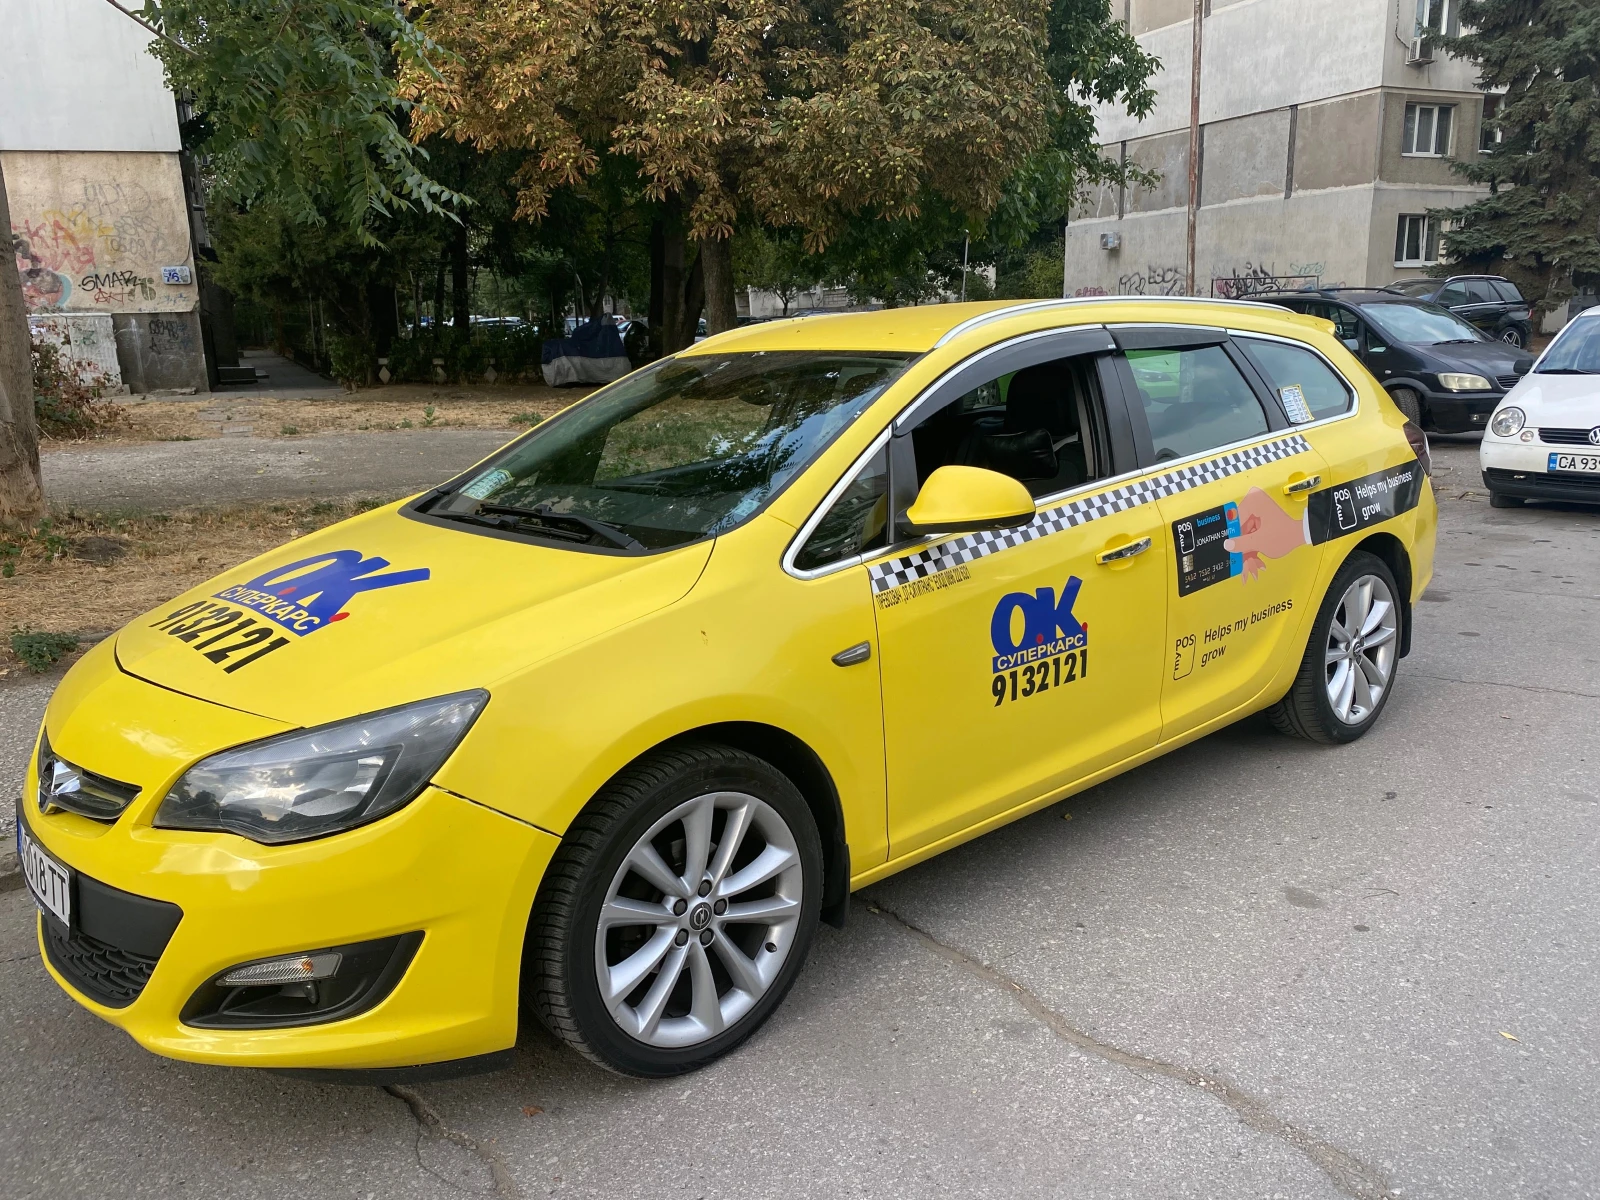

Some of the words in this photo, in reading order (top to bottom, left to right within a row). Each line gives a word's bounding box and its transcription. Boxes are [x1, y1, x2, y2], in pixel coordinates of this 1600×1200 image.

[1559, 456, 1577, 470] CA
[1581, 457, 1600, 471] 93
[1355, 484, 1377, 499] Helps
[1377, 480, 1388, 493] my
[1387, 471, 1413, 489] business
[1196, 513, 1221, 528] business
[1361, 502, 1381, 520] grow
[1196, 532, 1221, 547] JONATHAN
[219, 586, 321, 631] СУПЕРКАРС
[1204, 625, 1232, 644] Helps
[1234, 616, 1249, 632] my
[1250, 599, 1293, 625] business
[148, 600, 291, 674] 9132121
[997, 633, 1084, 670] СУПЕРКАРС
[1201, 645, 1227, 668] grow
[991, 649, 1088, 707] 9132121
[48, 864, 66, 916] TT
